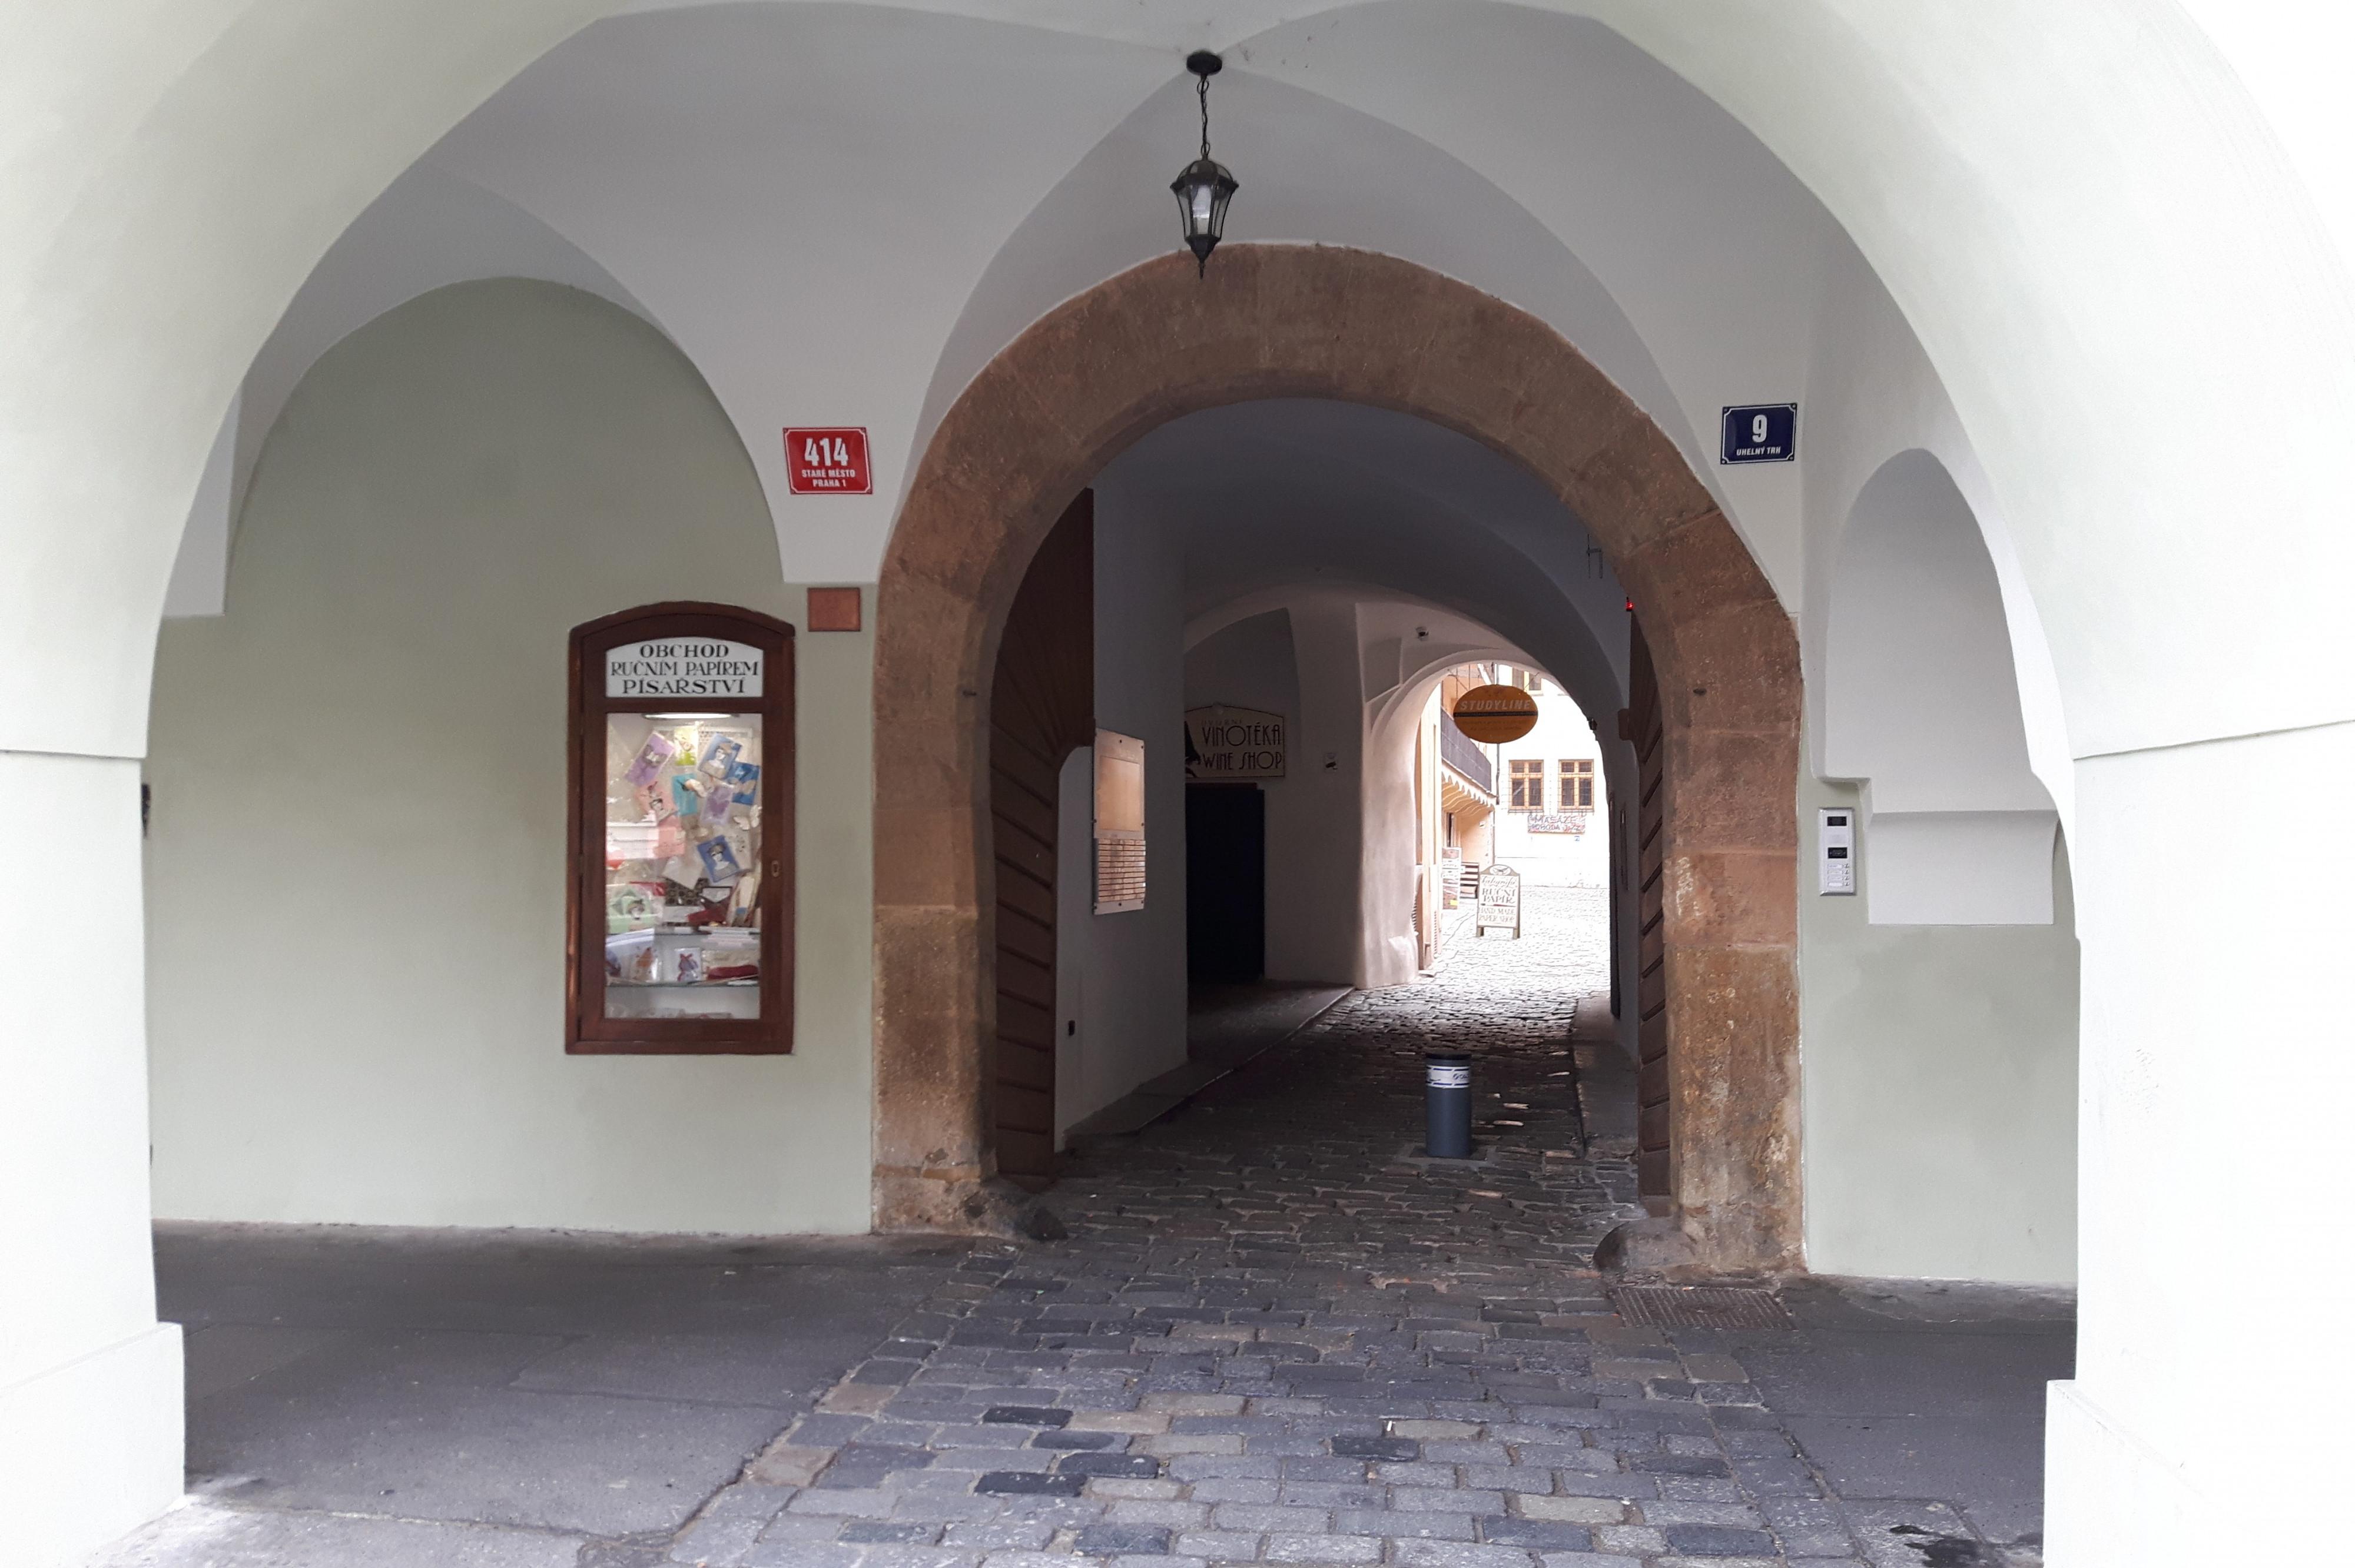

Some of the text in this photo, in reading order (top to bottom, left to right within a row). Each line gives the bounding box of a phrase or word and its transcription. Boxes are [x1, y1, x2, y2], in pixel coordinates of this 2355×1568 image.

[1752, 414, 1767, 443] 9
[804, 437, 848, 466] 414
[1736, 446, 1781, 456] UHELNÝ TRH
[801, 469, 826, 477] STARÉ
[639, 644, 729, 657] OBCHOD
[611, 659, 758, 676] RUČNÍM PAPÍREM
[1460, 699, 1531, 710] STUDYLINE
[1202, 722, 1281, 746] VINOTÉKA
[1202, 751, 1282, 770] WINE SHOP
